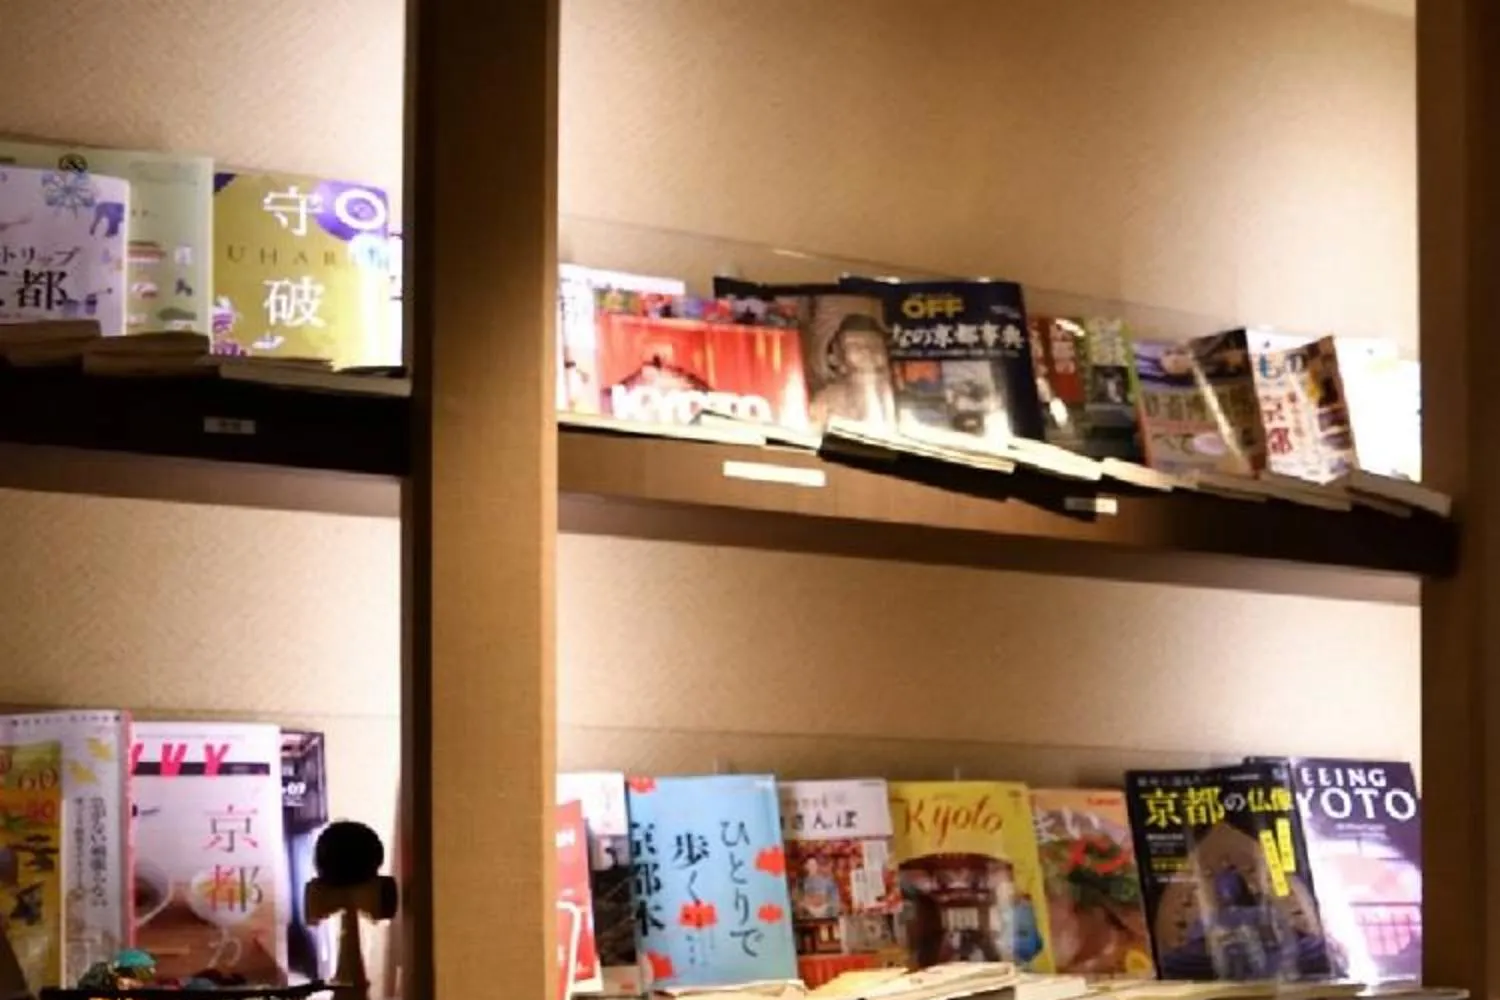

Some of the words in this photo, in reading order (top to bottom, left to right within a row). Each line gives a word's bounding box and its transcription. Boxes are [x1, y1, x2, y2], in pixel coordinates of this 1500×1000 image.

[263, 185, 325, 237] 守
[263, 275, 327, 328] 破
[903, 297, 964, 319] OFF
[903, 797, 1004, 848] Kyoto
[1296, 787, 1417, 822] YOTO
[720, 820, 765, 958] ひとりで
